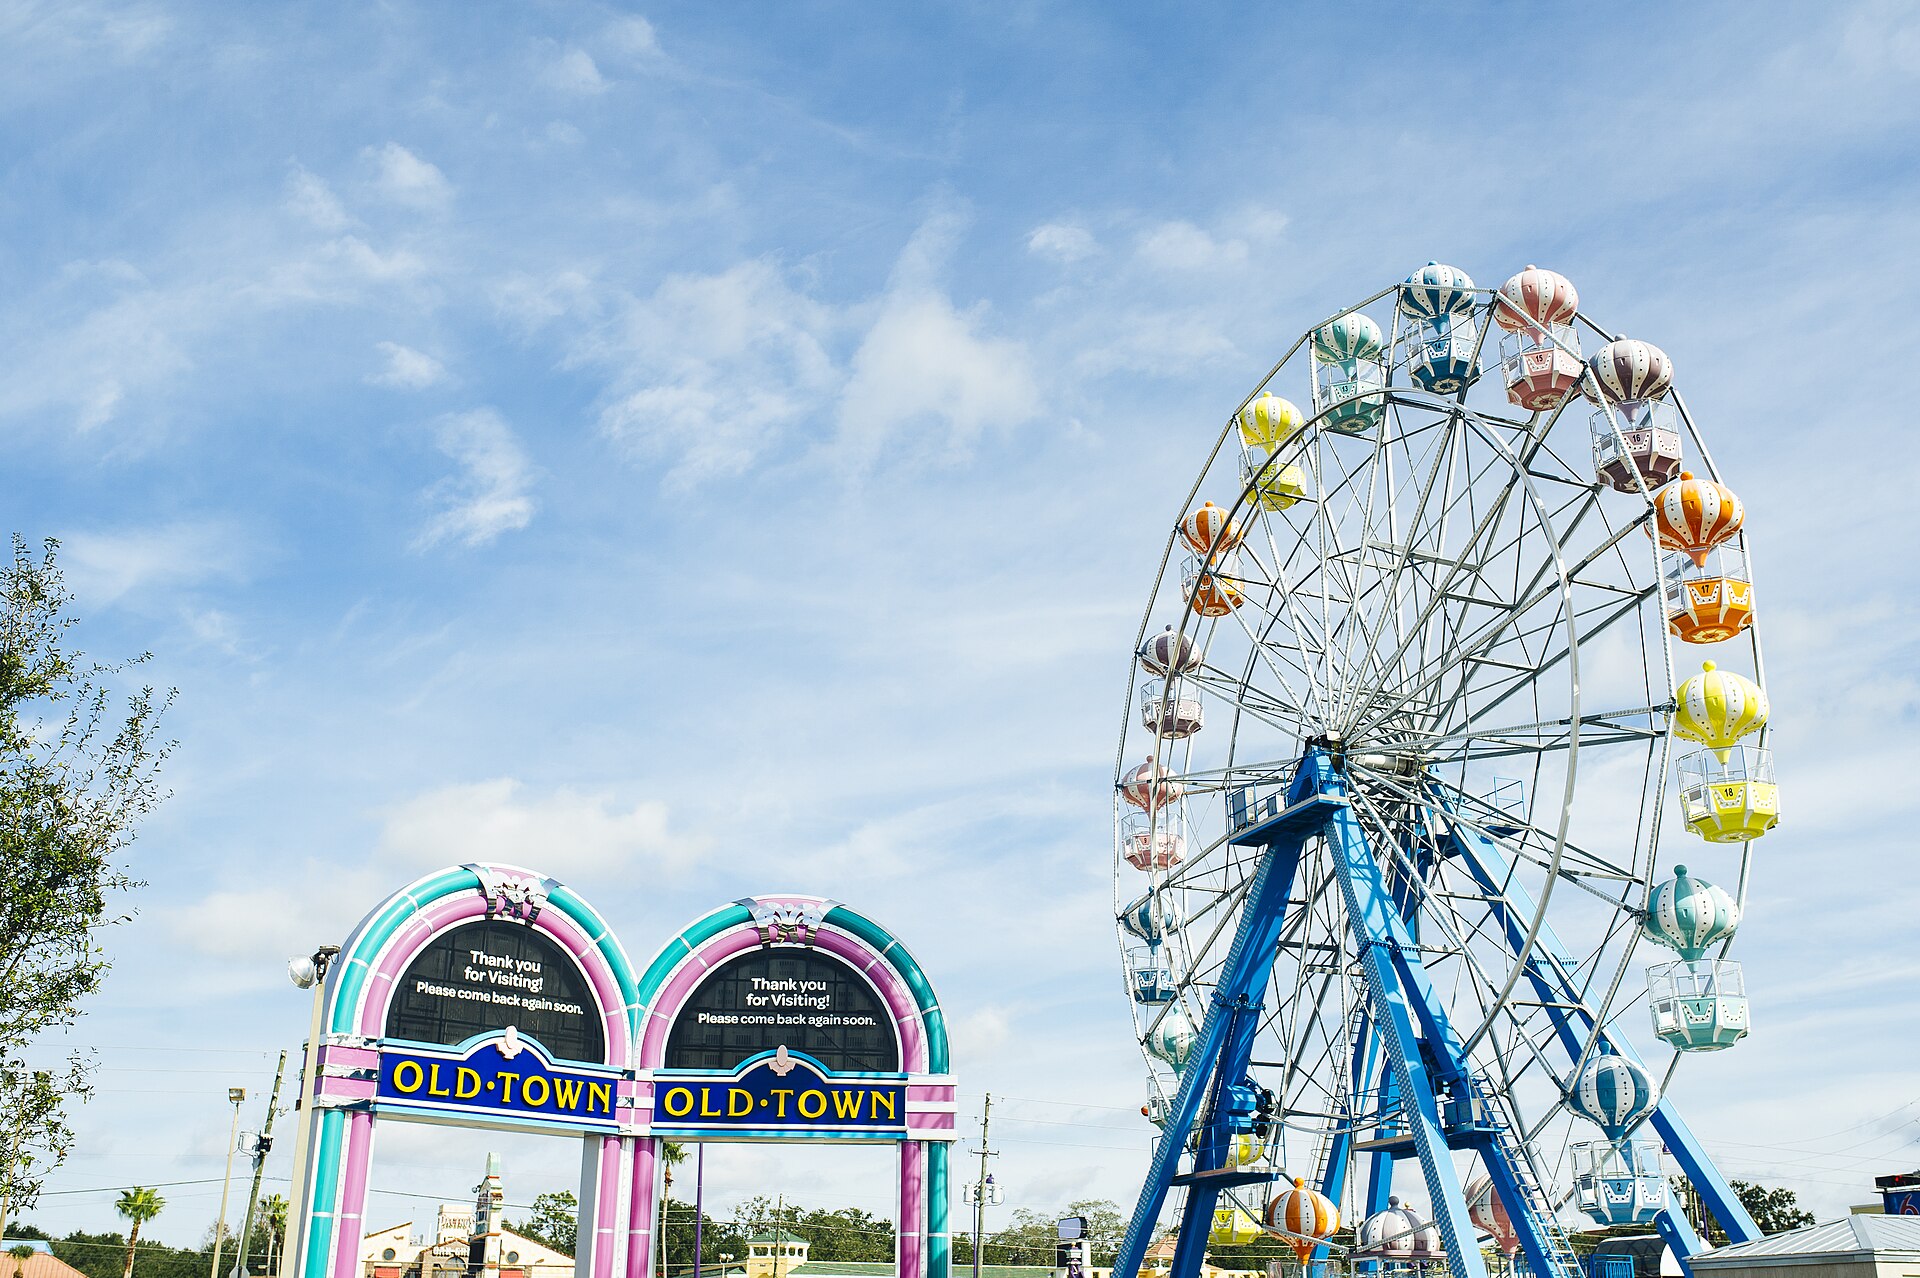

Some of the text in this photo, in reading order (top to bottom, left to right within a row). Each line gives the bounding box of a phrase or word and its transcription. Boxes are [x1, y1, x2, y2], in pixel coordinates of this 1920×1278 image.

[1535, 354, 1544, 363] 15
[1632, 433, 1641, 443] 16
[1701, 584, 1710, 593] 17
[1724, 787, 1734, 797] 18
[470, 950, 541, 973] Thank you
[464, 966, 544, 993] for Visiting!
[751, 977, 826, 993] Thank you
[416, 981, 584, 1015] Please come back again soon.
[746, 993, 830, 1010] for Visiting!
[698, 1012, 877, 1028] Please come back again soon.
[1616, 1182, 1622, 1192] 2
[1899, 1193, 1919, 1215] 6
